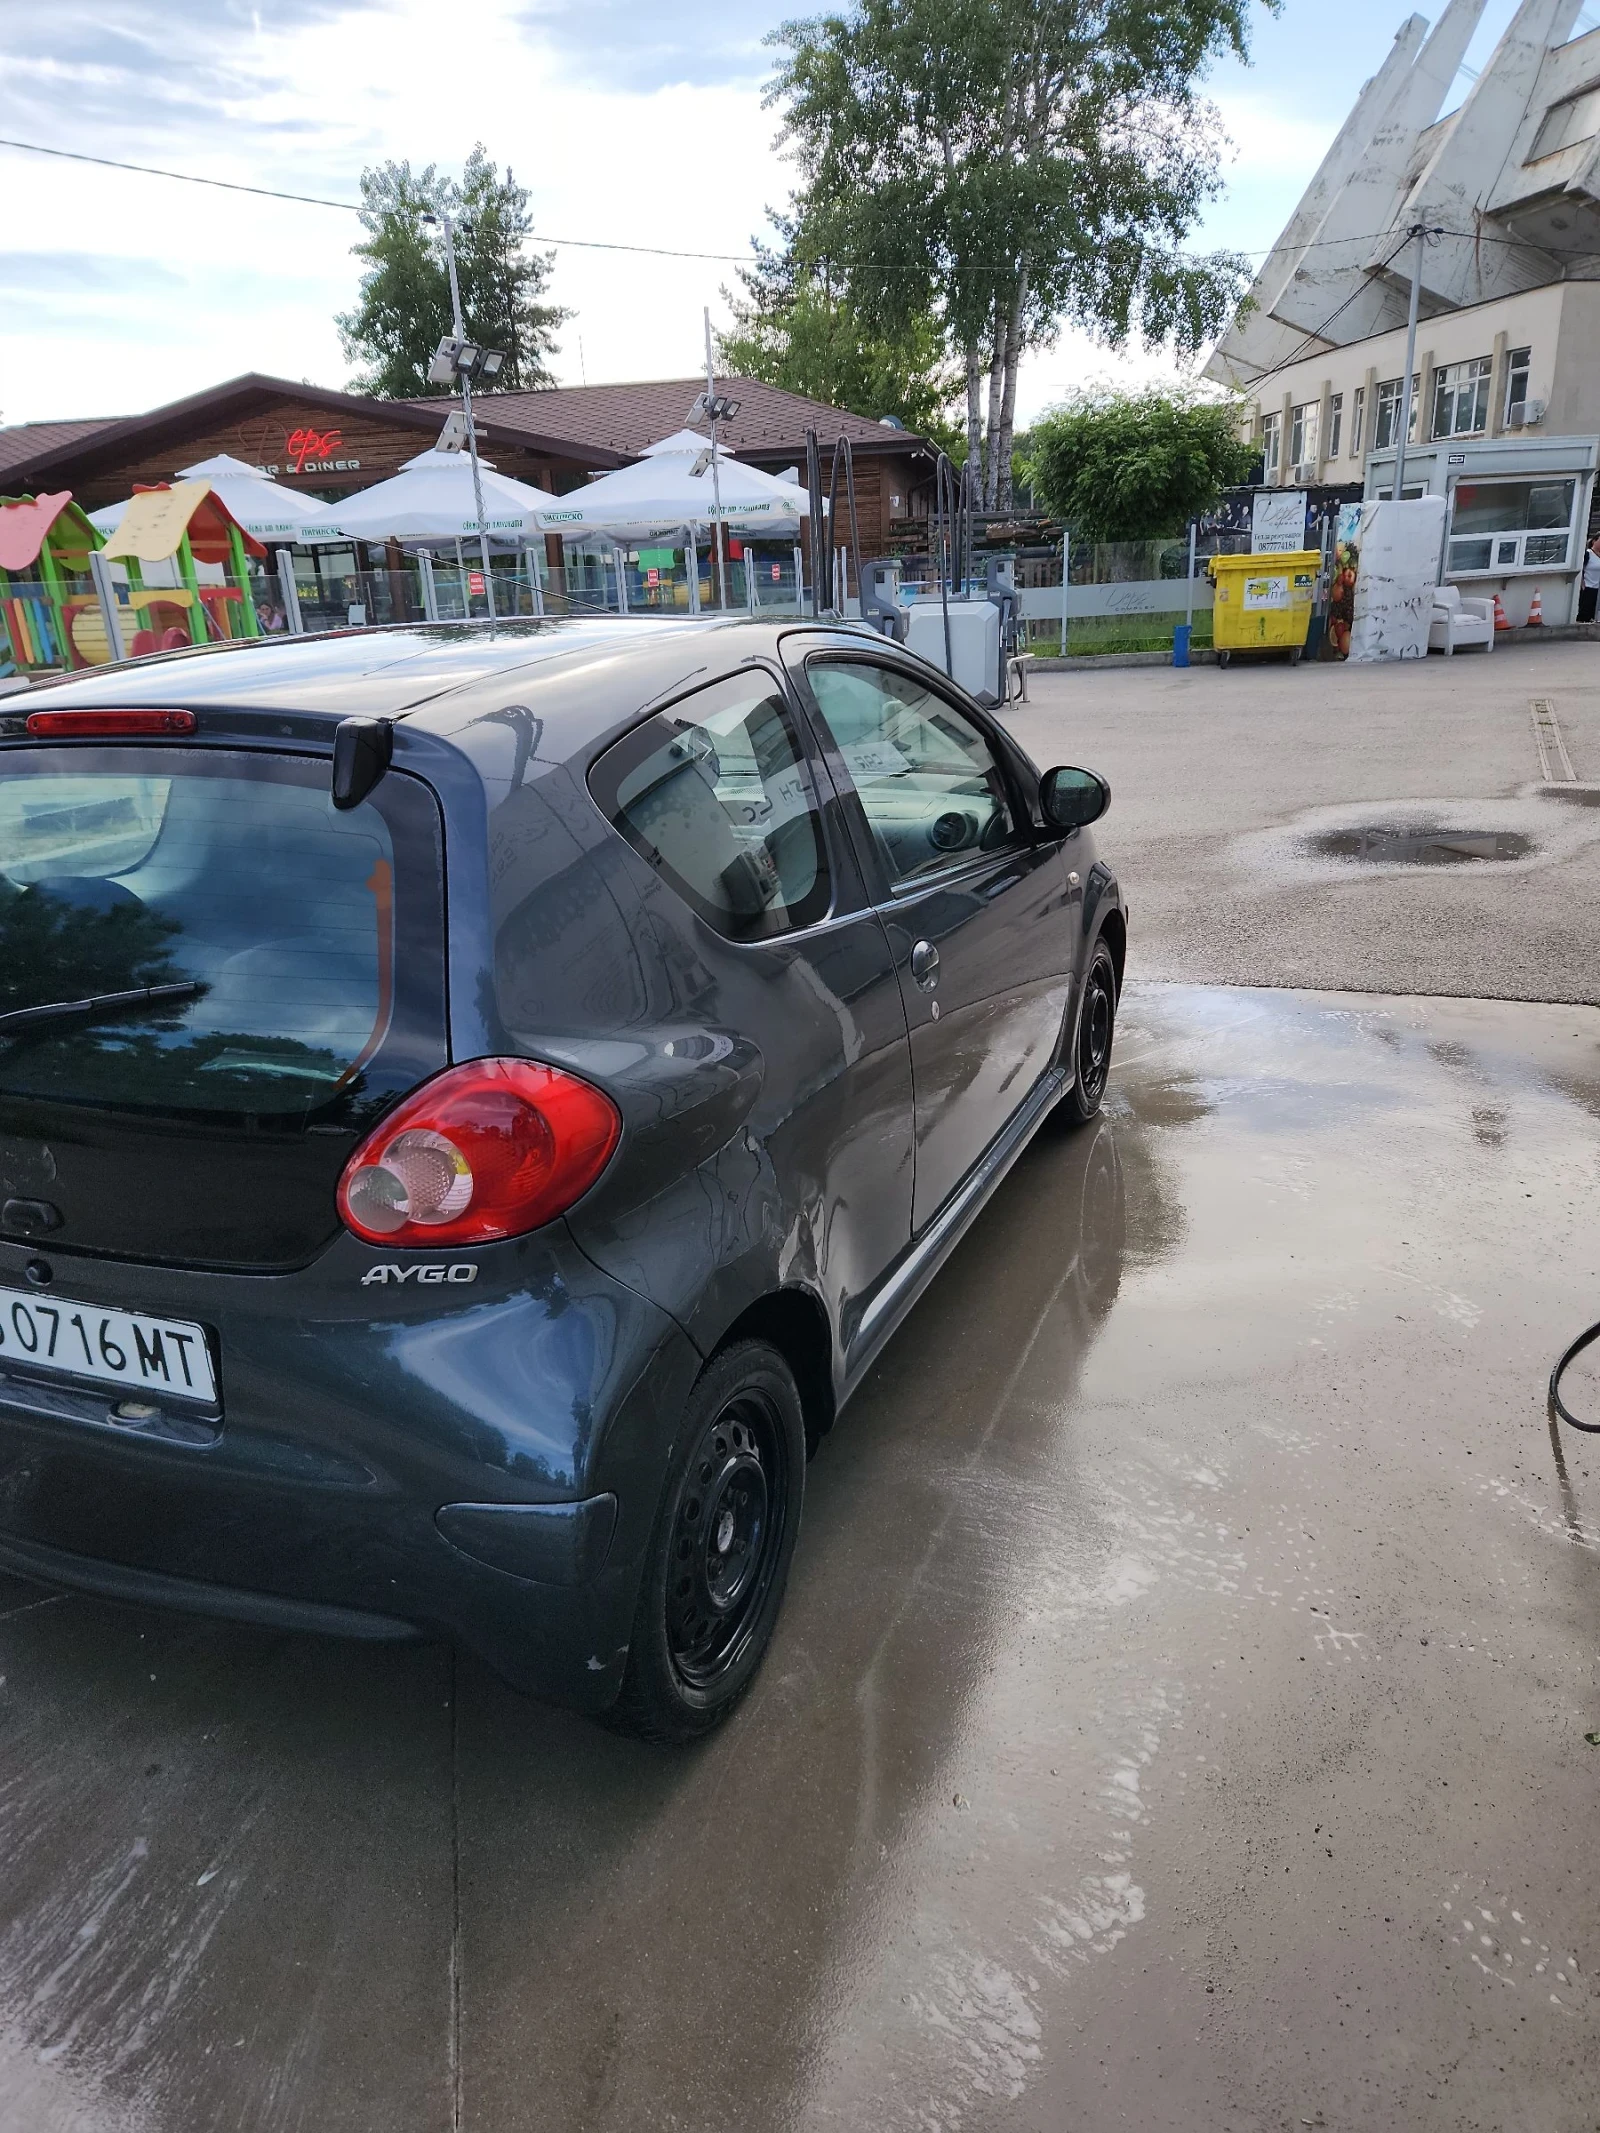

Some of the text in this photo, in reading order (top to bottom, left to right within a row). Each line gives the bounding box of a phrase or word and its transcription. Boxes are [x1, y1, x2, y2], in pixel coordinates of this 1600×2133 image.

[256, 465, 279, 474] AR
[305, 460, 360, 472] DINER
[301, 527, 342, 536] ПИРИНСКО
[361, 1264, 478, 1285] AYGO
